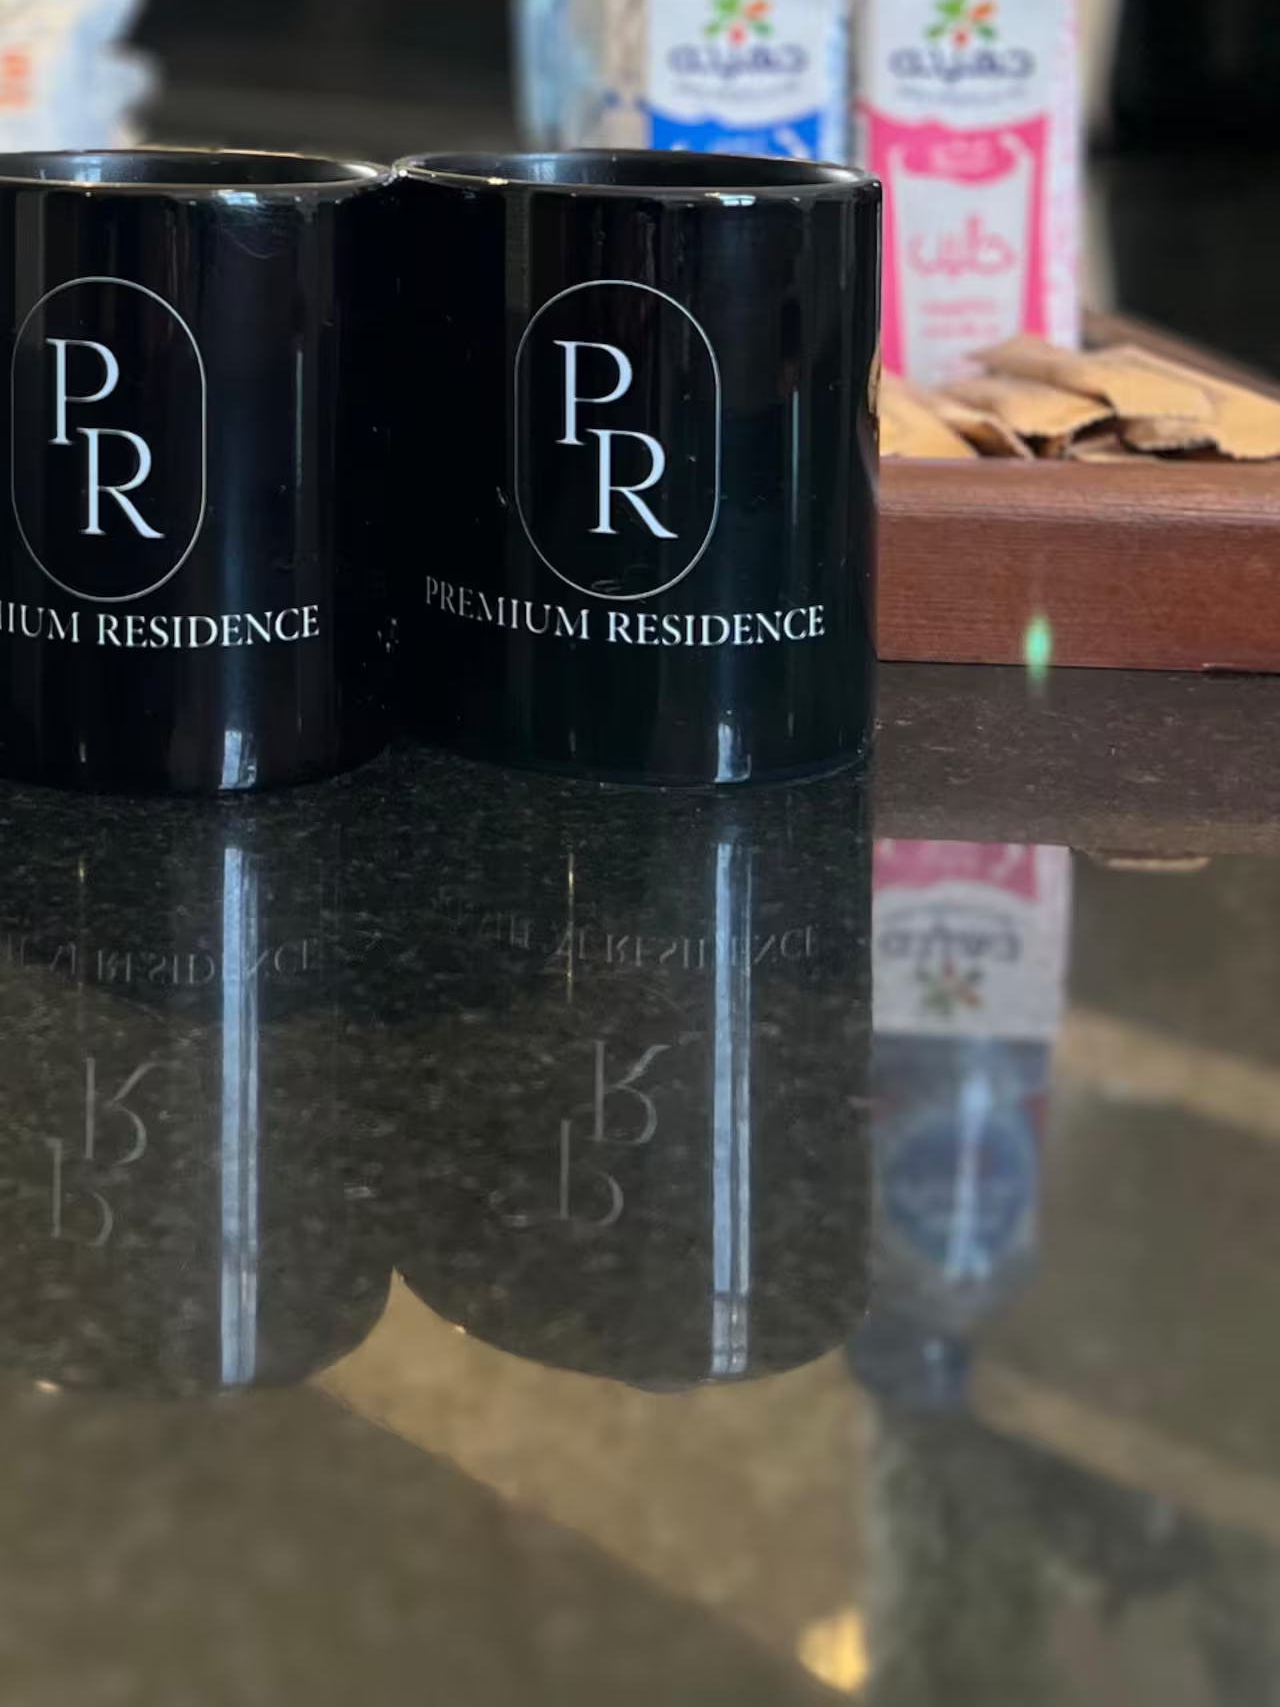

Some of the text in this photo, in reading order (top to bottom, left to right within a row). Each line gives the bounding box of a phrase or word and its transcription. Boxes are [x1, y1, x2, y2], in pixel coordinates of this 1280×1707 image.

[96, 604, 320, 649] RESIDENCE
[426, 575, 826, 647] PREMIUM RESIDENCE
